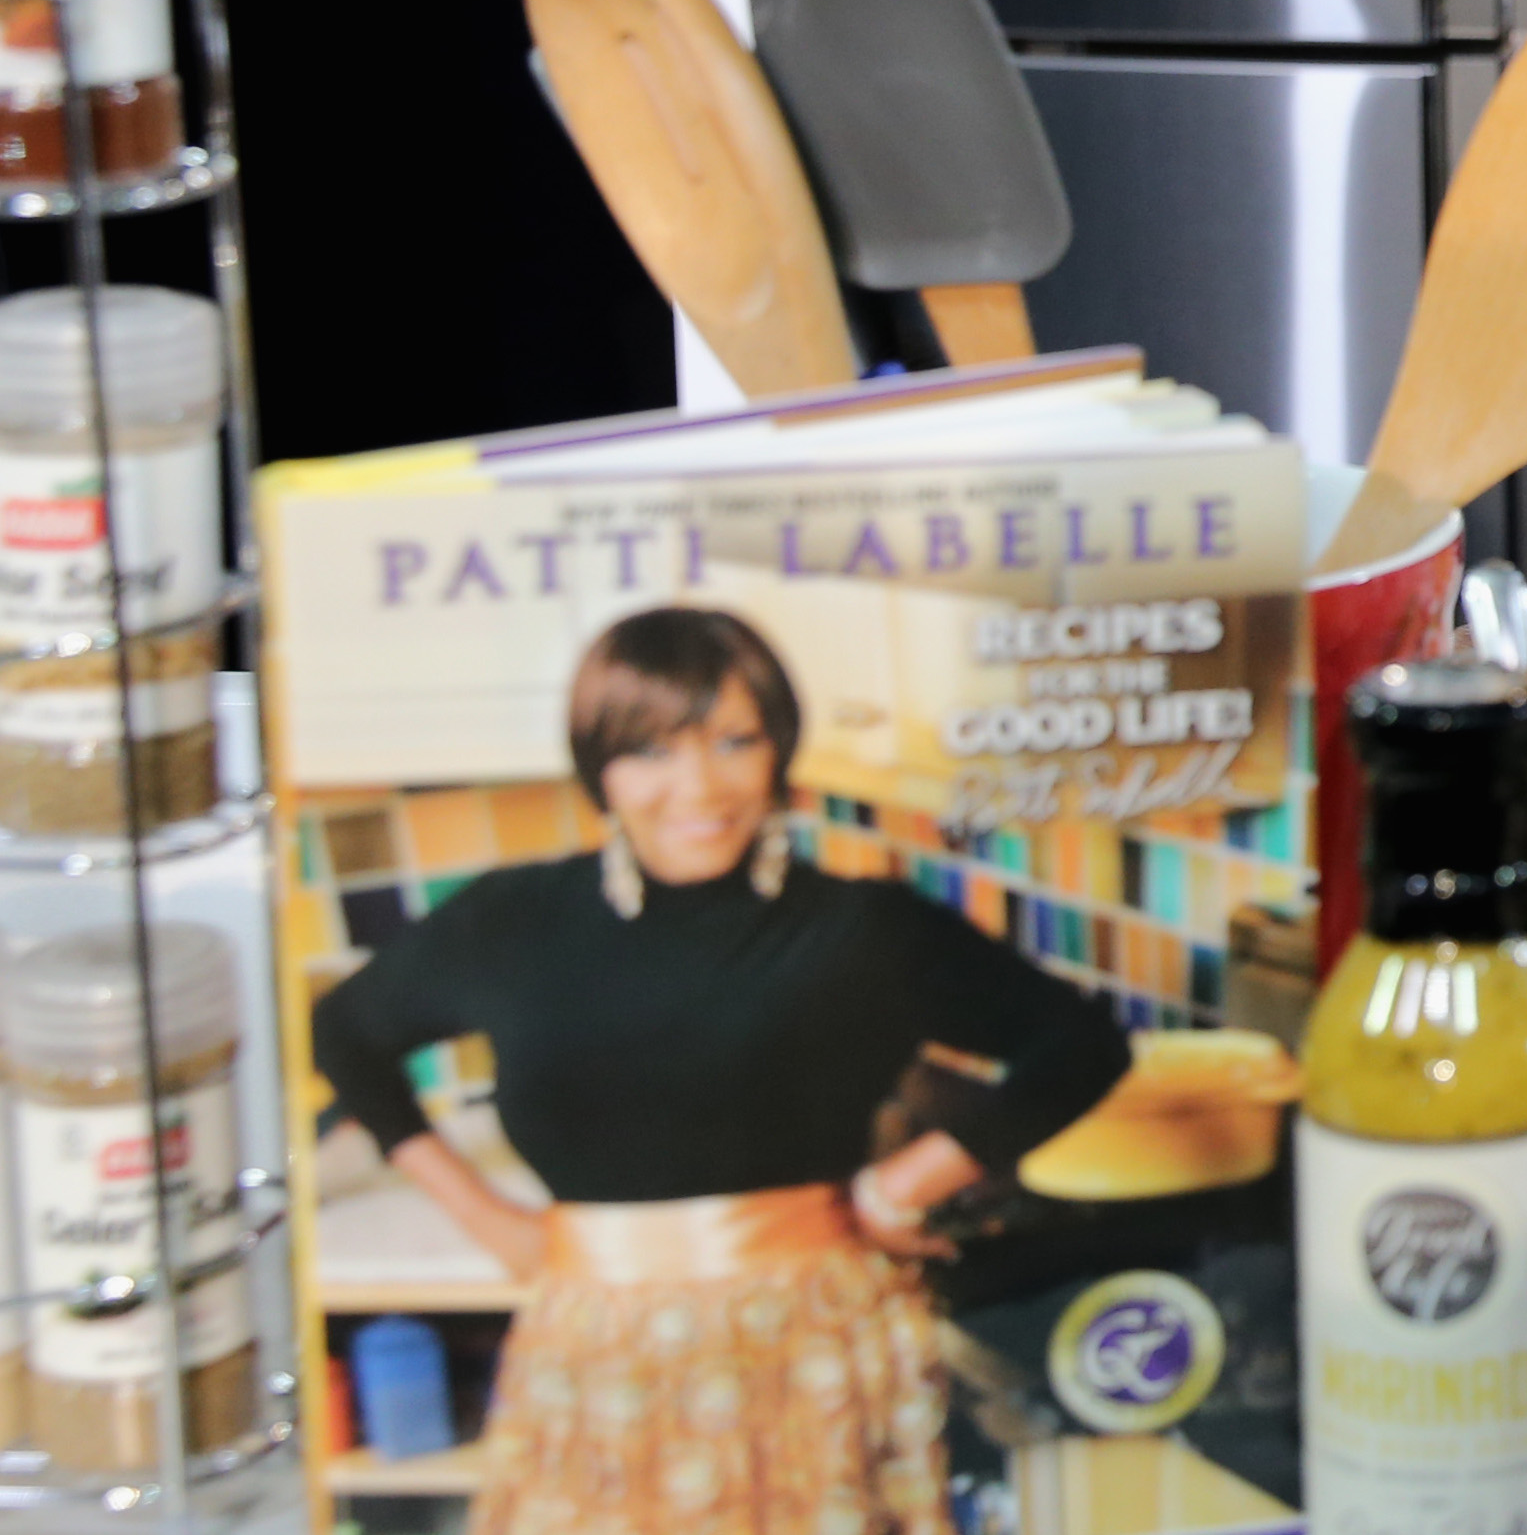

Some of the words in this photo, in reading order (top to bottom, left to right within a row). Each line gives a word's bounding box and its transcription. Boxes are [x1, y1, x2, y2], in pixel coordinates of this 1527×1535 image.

[376, 519, 707, 607] PATTI
[779, 495, 1238, 579] LABELLE
[976, 597, 1224, 663] RECIPES
[1104, 656, 1170, 694] THE
[943, 697, 1114, 757] GOOD
[1115, 687, 1255, 747] LIFE!
